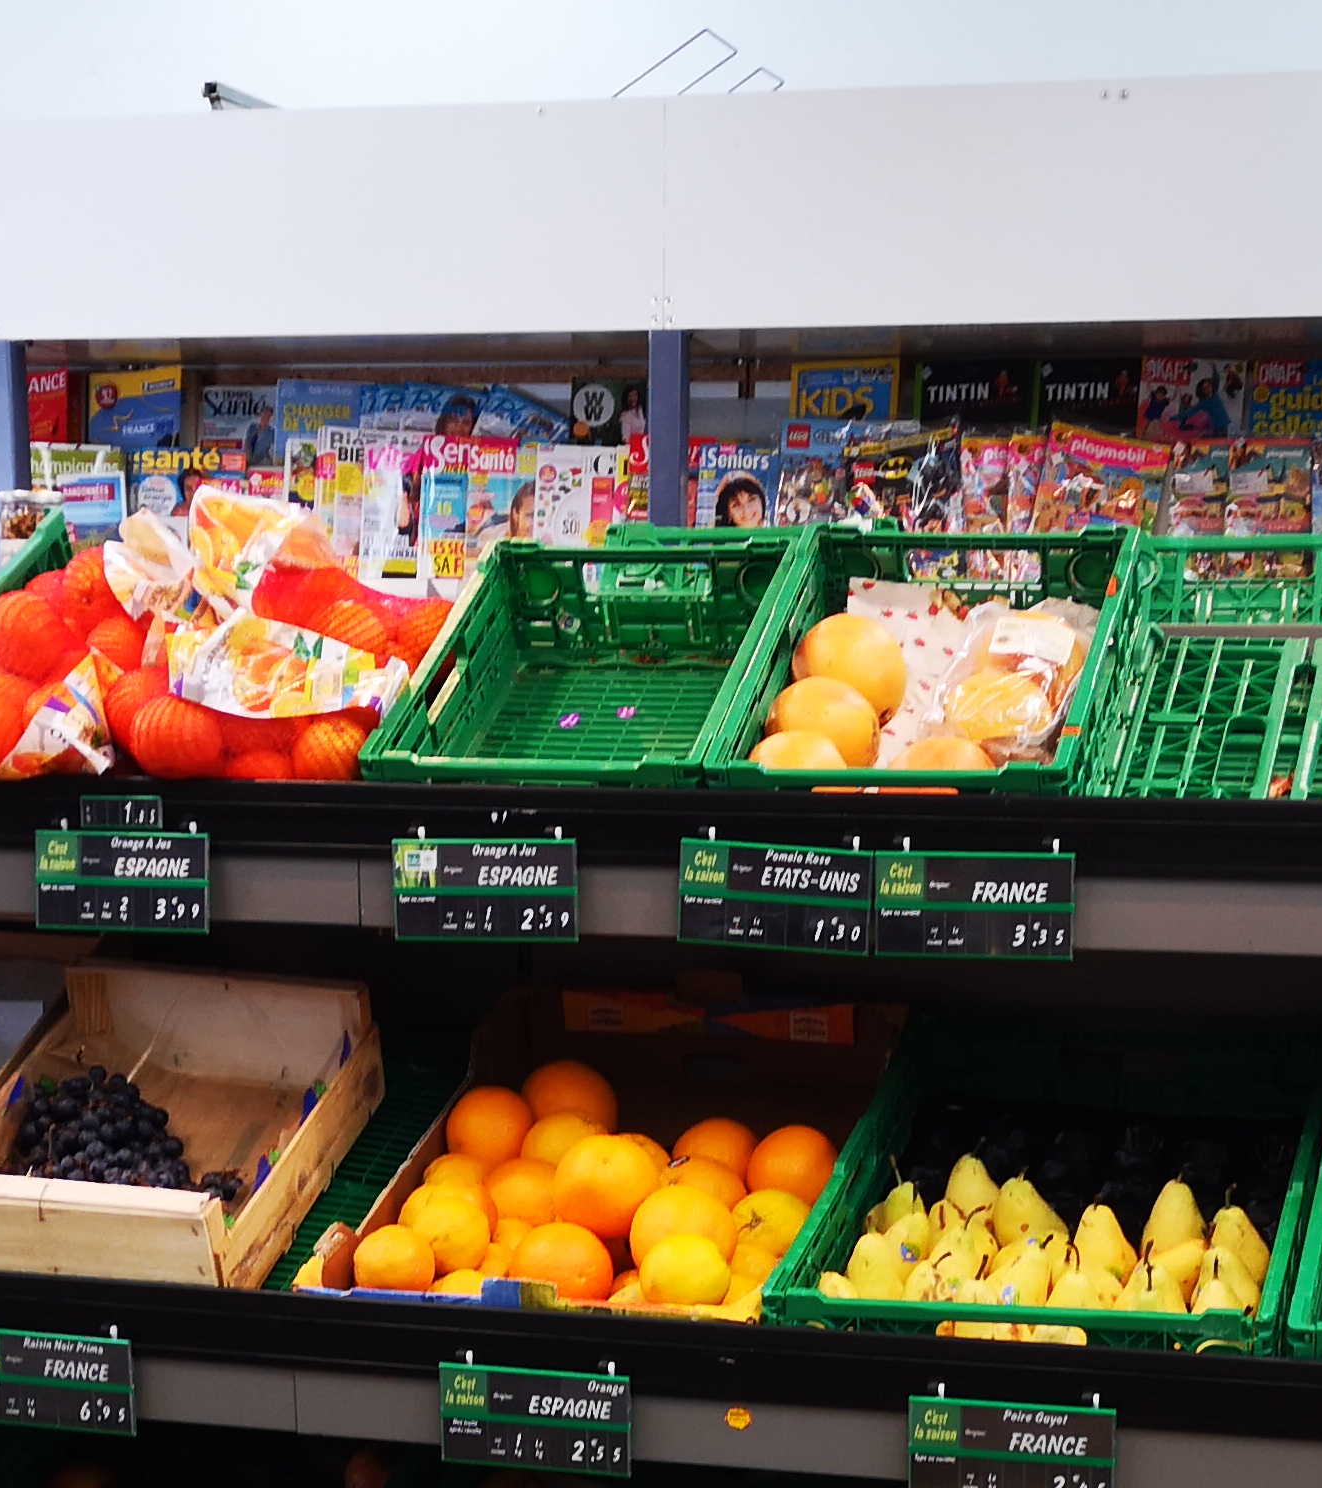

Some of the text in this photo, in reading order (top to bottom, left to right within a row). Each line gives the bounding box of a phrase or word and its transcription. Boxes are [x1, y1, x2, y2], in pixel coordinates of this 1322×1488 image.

[928, 382, 990, 403] TINTIN
[1045, 381, 1110, 401] TINTIN
[141, 446, 220, 471] santé
[1071, 438, 1147, 465] playmobil
[111, 836, 144, 852] Orange
[472, 844, 507, 859] Orange
[114, 857, 190, 878] ESPAGNE
[765, 849, 831, 865] Pomelo Rose
[478, 865, 559, 886] ESPAGNE
[761, 866, 861, 893] ETATS-UNIS
[972, 881, 1049, 904] FRANCE
[23, 1337, 52, 1350] Raisin
[44, 1358, 109, 1382] FRANCE
[587, 1380, 625, 1397] Orange
[528, 1394, 612, 1421] ESPAGNE
[1003, 1409, 1069, 1429] Poire Guyot
[1008, 1432, 1088, 1456] FRANCE
